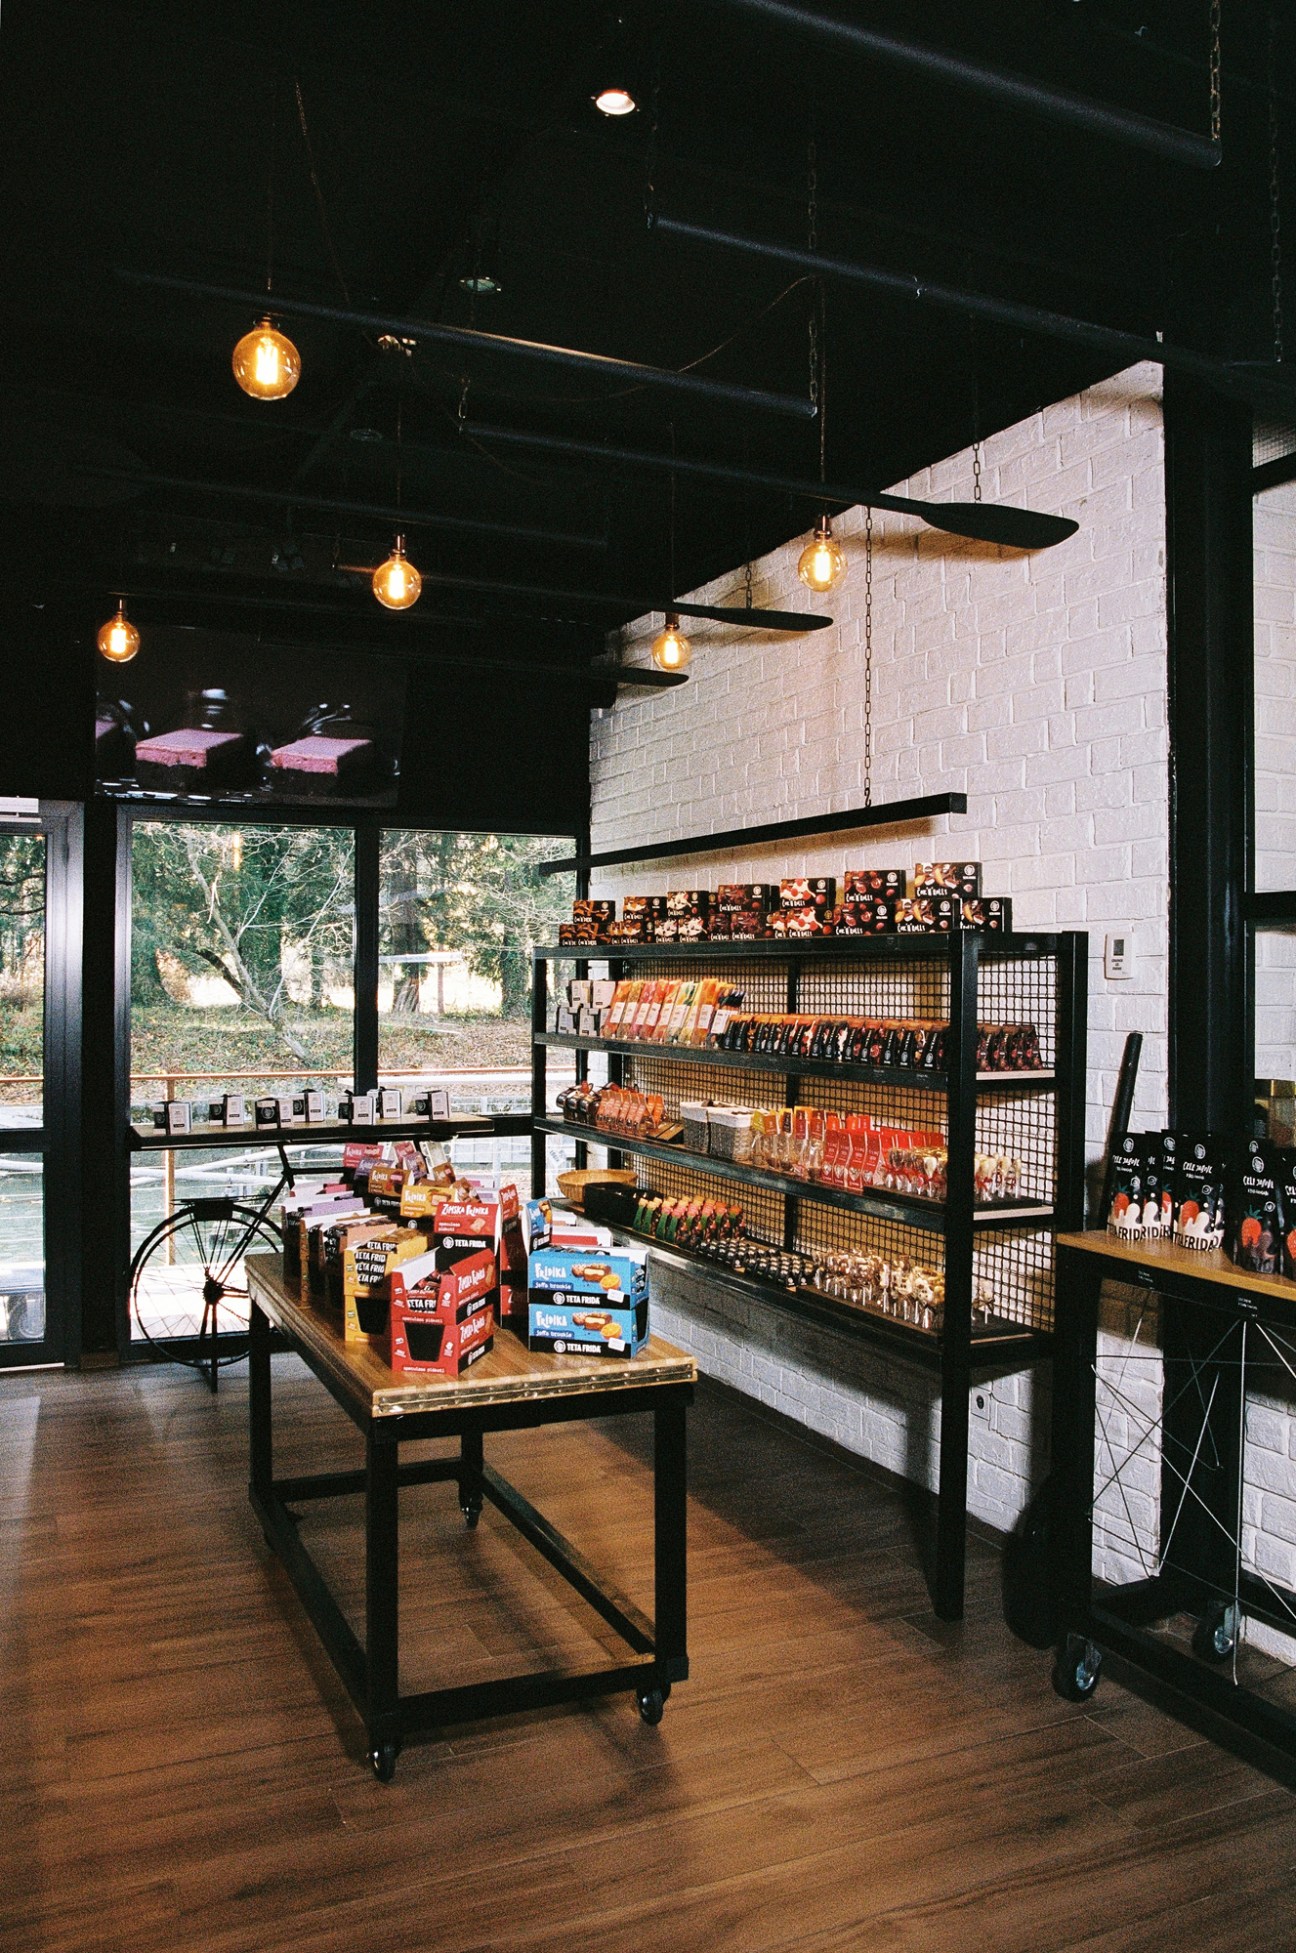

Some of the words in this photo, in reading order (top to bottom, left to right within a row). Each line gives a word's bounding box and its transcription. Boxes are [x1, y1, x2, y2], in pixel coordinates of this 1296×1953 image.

[441, 1204, 465, 1215] ZIMSKA
[466, 1204, 489, 1216] FRIDIKA
[454, 1239, 469, 1247] TETA
[470, 1240, 487, 1248] FRIDA
[371, 1253, 386, 1262] FRID
[370, 1264, 385, 1273] FRID
[534, 1263, 567, 1280] FRIDIKA
[357, 1274, 369, 1282] ETA
[424, 1300, 437, 1308] FRI
[566, 1295, 580, 1303] TETA
[581, 1296, 600, 1304] FRIDA
[535, 1311, 568, 1328] FRIDIKA
[567, 1343, 581, 1351] TETA
[582, 1344, 601, 1353] FRIDA
